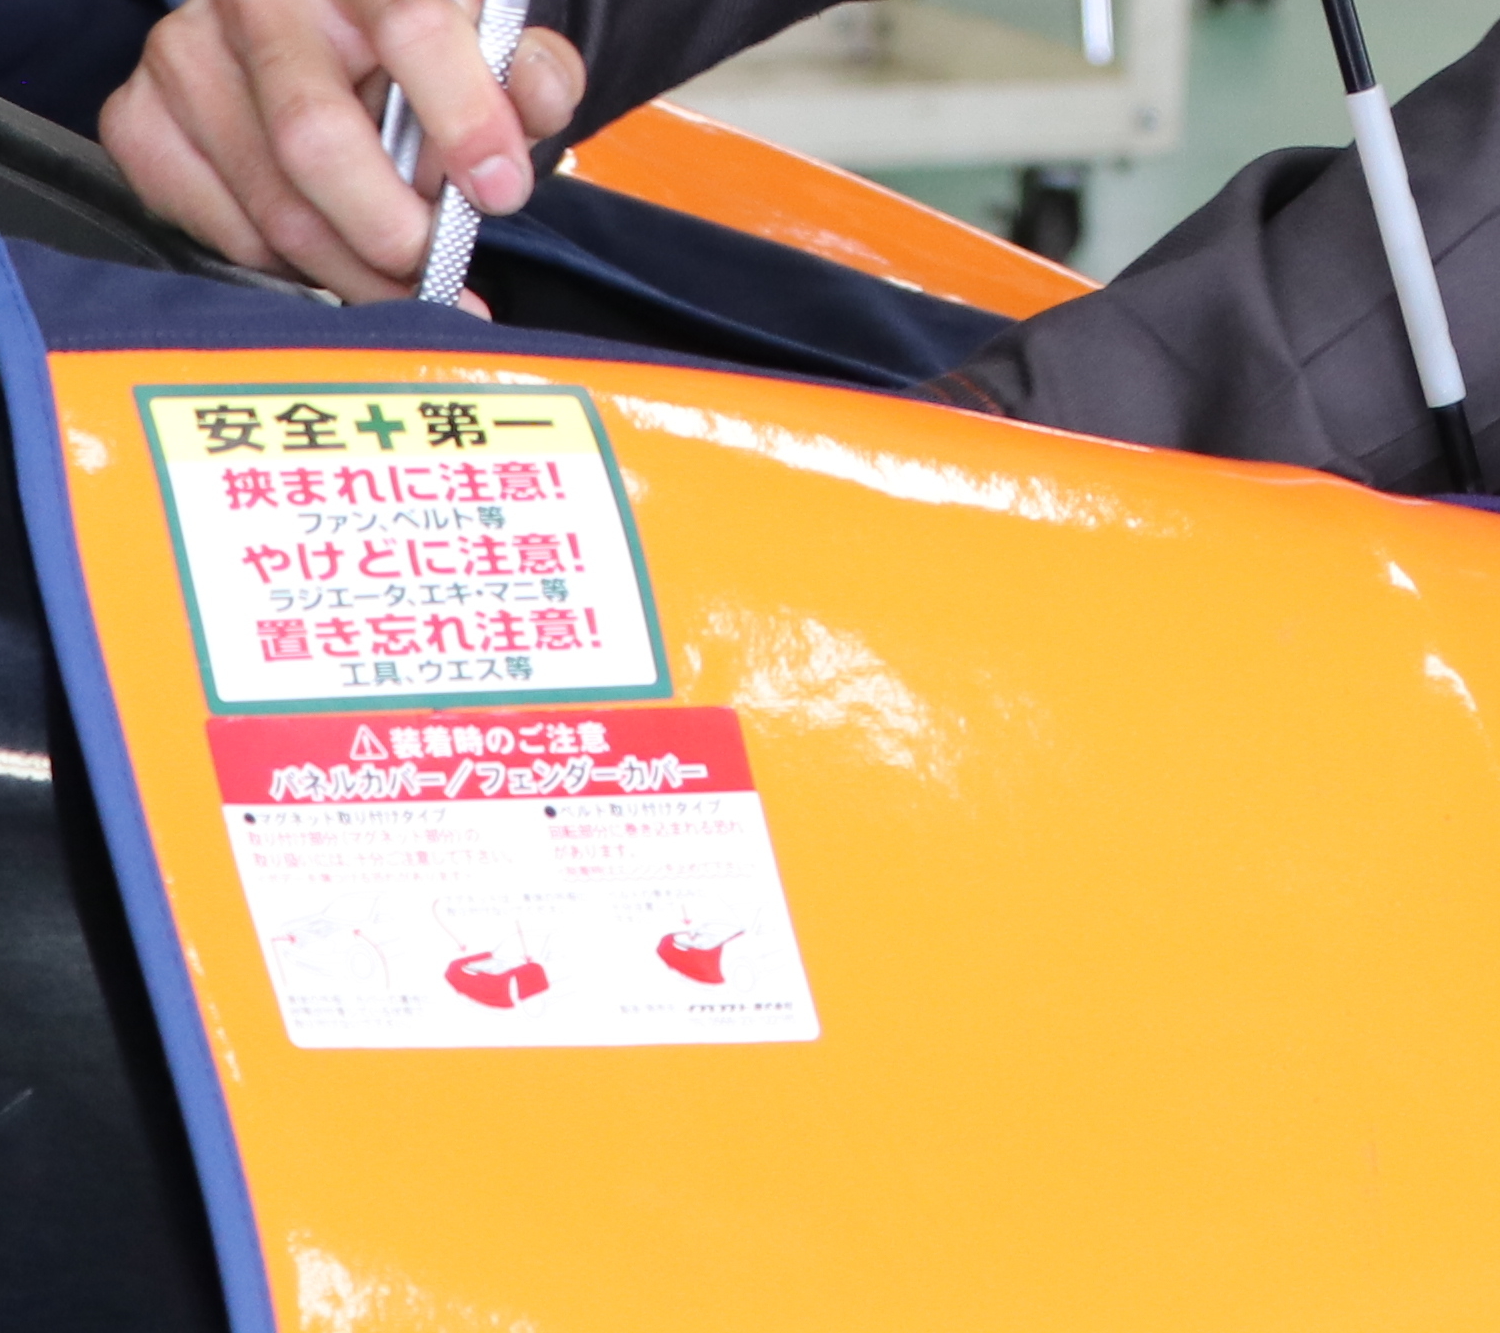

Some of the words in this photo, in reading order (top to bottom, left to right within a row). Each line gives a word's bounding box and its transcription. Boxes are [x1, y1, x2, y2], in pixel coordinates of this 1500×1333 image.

[222, 460, 567, 510] 挟まれに注意!
[298, 505, 507, 535] ファン、ベルト等
[241, 532, 586, 584] やけどに注意!
[256, 607, 603, 662] 置き忘れ注意!
[340, 655, 534, 687] 工具、ウエス等
[389, 720, 610, 759] 装着時のご注意
